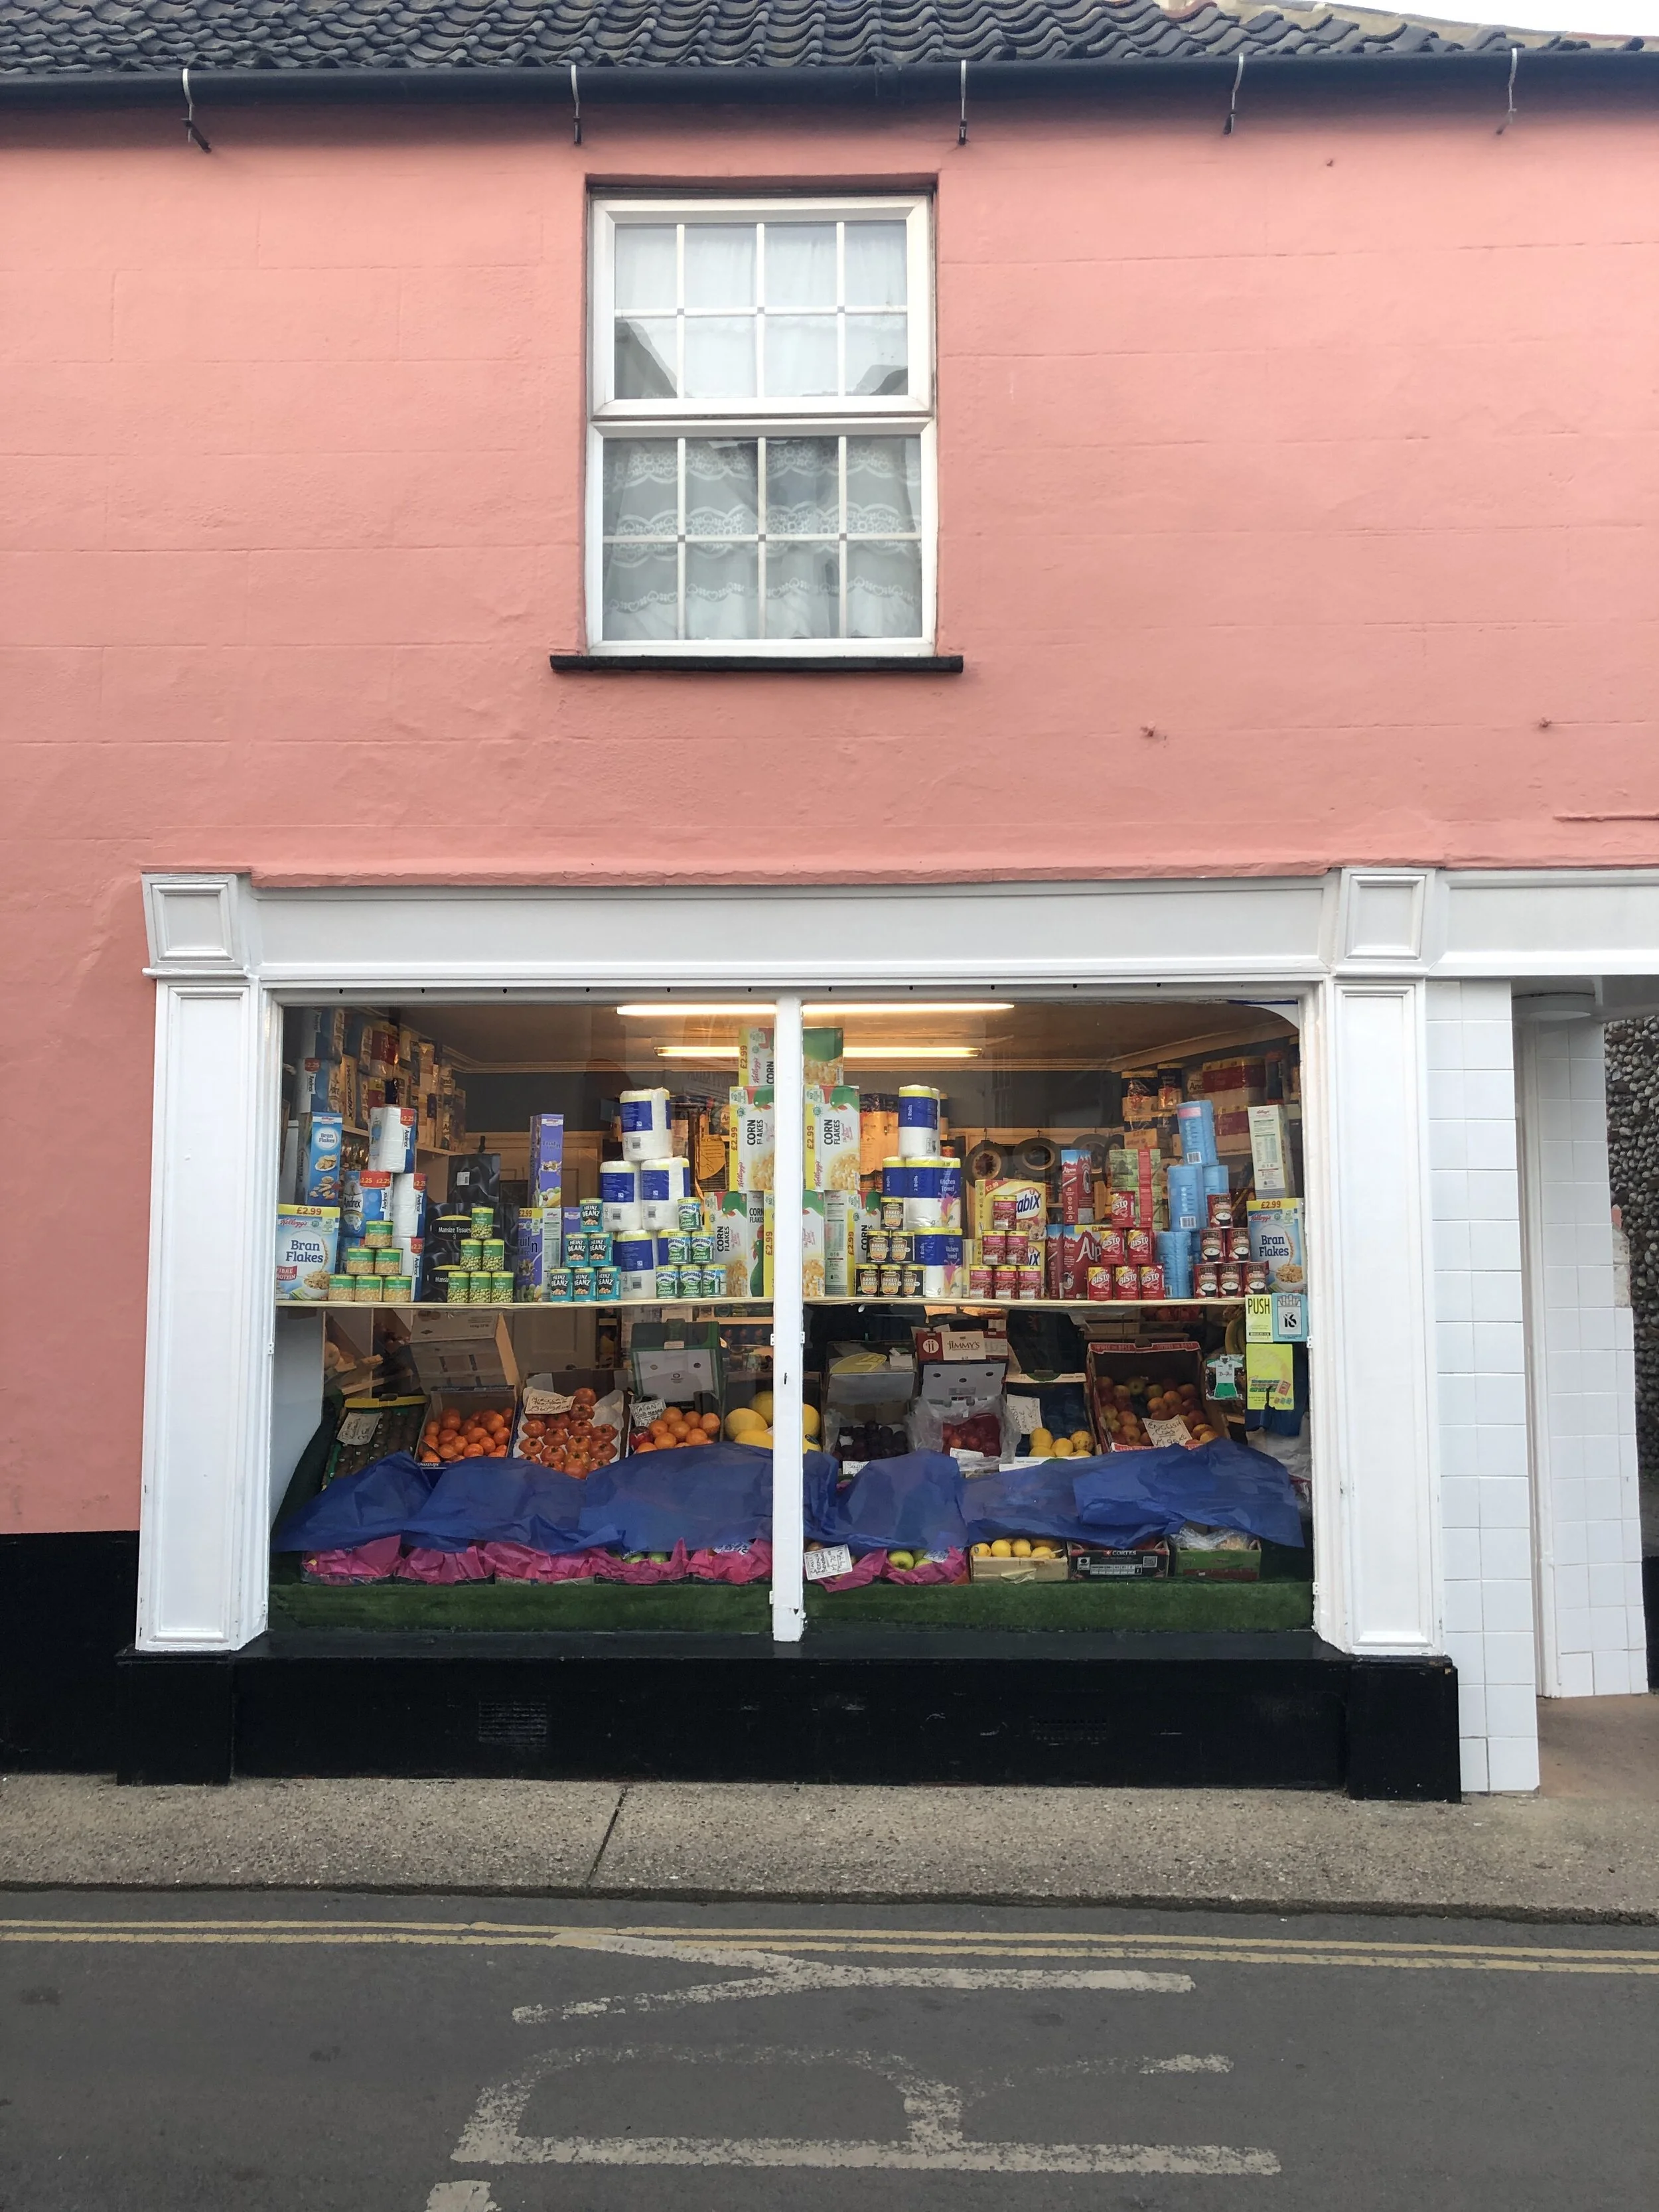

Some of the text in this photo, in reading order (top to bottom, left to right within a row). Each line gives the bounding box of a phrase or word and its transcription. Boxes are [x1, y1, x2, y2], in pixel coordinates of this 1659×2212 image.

[747, 1120, 757, 1145] CORN
[824, 1119, 833, 1145] CORN
[814, 1161, 822, 1187] Kellogg's
[344, 1197, 362, 1208] Andrex
[1261, 1201, 1281, 1209] £2.99
[296, 1207, 322, 1215] £2.99
[749, 1207, 764, 1217] CORN
[280, 1218, 307, 1227] Kellogg's
[291, 1240, 320, 1252] Bran
[1102, 1236, 1120, 1248] BISTO
[1130, 1236, 1149, 1247] BISTO
[1261, 1235, 1285, 1245] Bran
[531, 1241, 538, 1253] n
[1076, 1237, 1102, 1263] Alp
[1259, 1246, 1289, 1257] Flakes
[285, 1251, 323, 1263] Flakes
[1092, 1273, 1110, 1285] BISTO
[1119, 1273, 1137, 1284] BISTO
[1141, 1272, 1160, 1284] BISTO
[1248, 1297, 1270, 1315] PUSH
